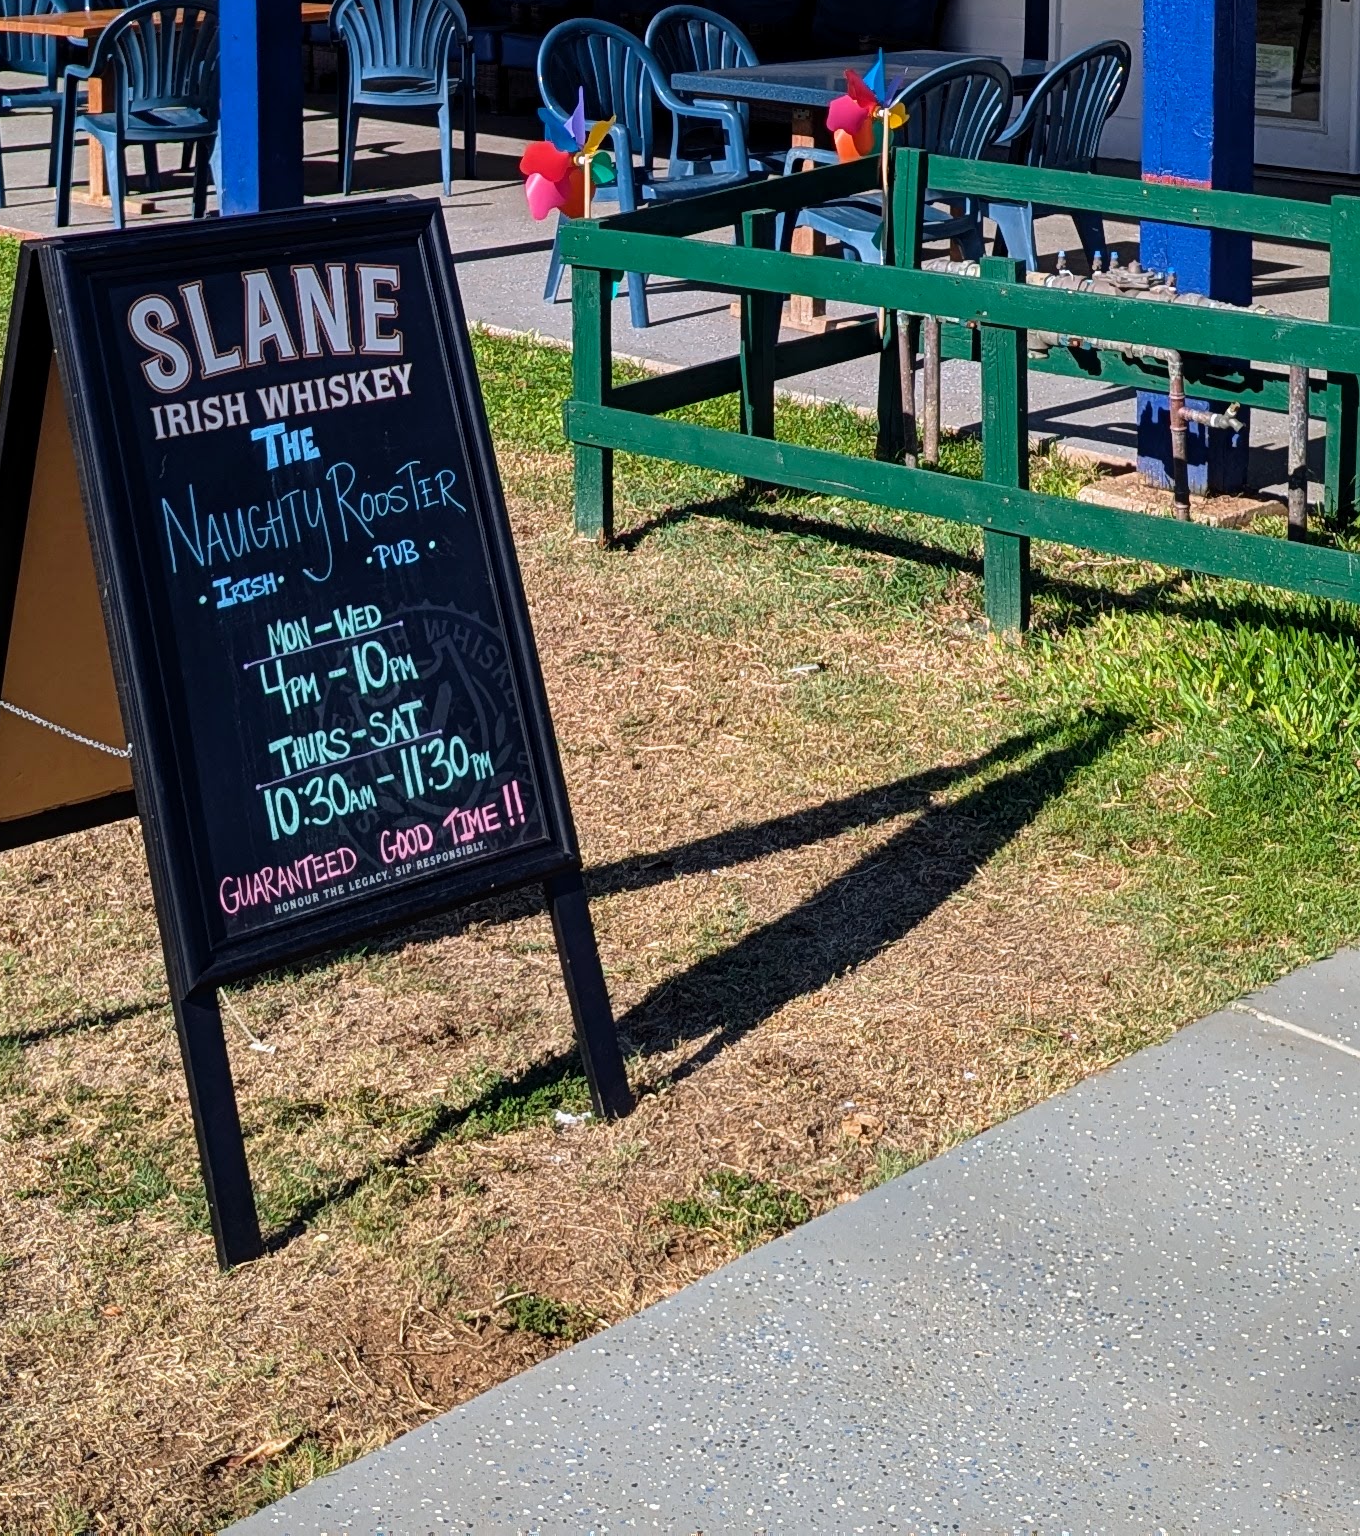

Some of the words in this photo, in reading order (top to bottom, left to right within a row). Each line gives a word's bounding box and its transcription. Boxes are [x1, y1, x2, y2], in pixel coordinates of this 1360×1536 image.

[127, 263, 404, 394] SLANE
[150, 391, 250, 441] IRISH
[255, 363, 413, 421] WHISKEY
[250, 422, 322, 471] THE
[161, 483, 333, 582] NAUGHTY
[325, 460, 467, 543] ROOSTER
[212, 572, 278, 609] IRISH
[372, 539, 420, 570] PUB
[260, 659, 322, 715] 4PM
[352, 640, 419, 695] 10PM
[264, 773, 378, 841] 10:30AM
[400, 735, 495, 800] 11:30PM
[219, 847, 357, 915] GUARANTEED
[380, 823, 434, 864] GOOD
[274, 892, 320, 915] HONOUR
[323, 884, 345, 900] THE
[348, 870, 392, 892] LEGACY.
[395, 864, 413, 877] SIP
[415, 840, 488, 870] RESPONSIBLY.
